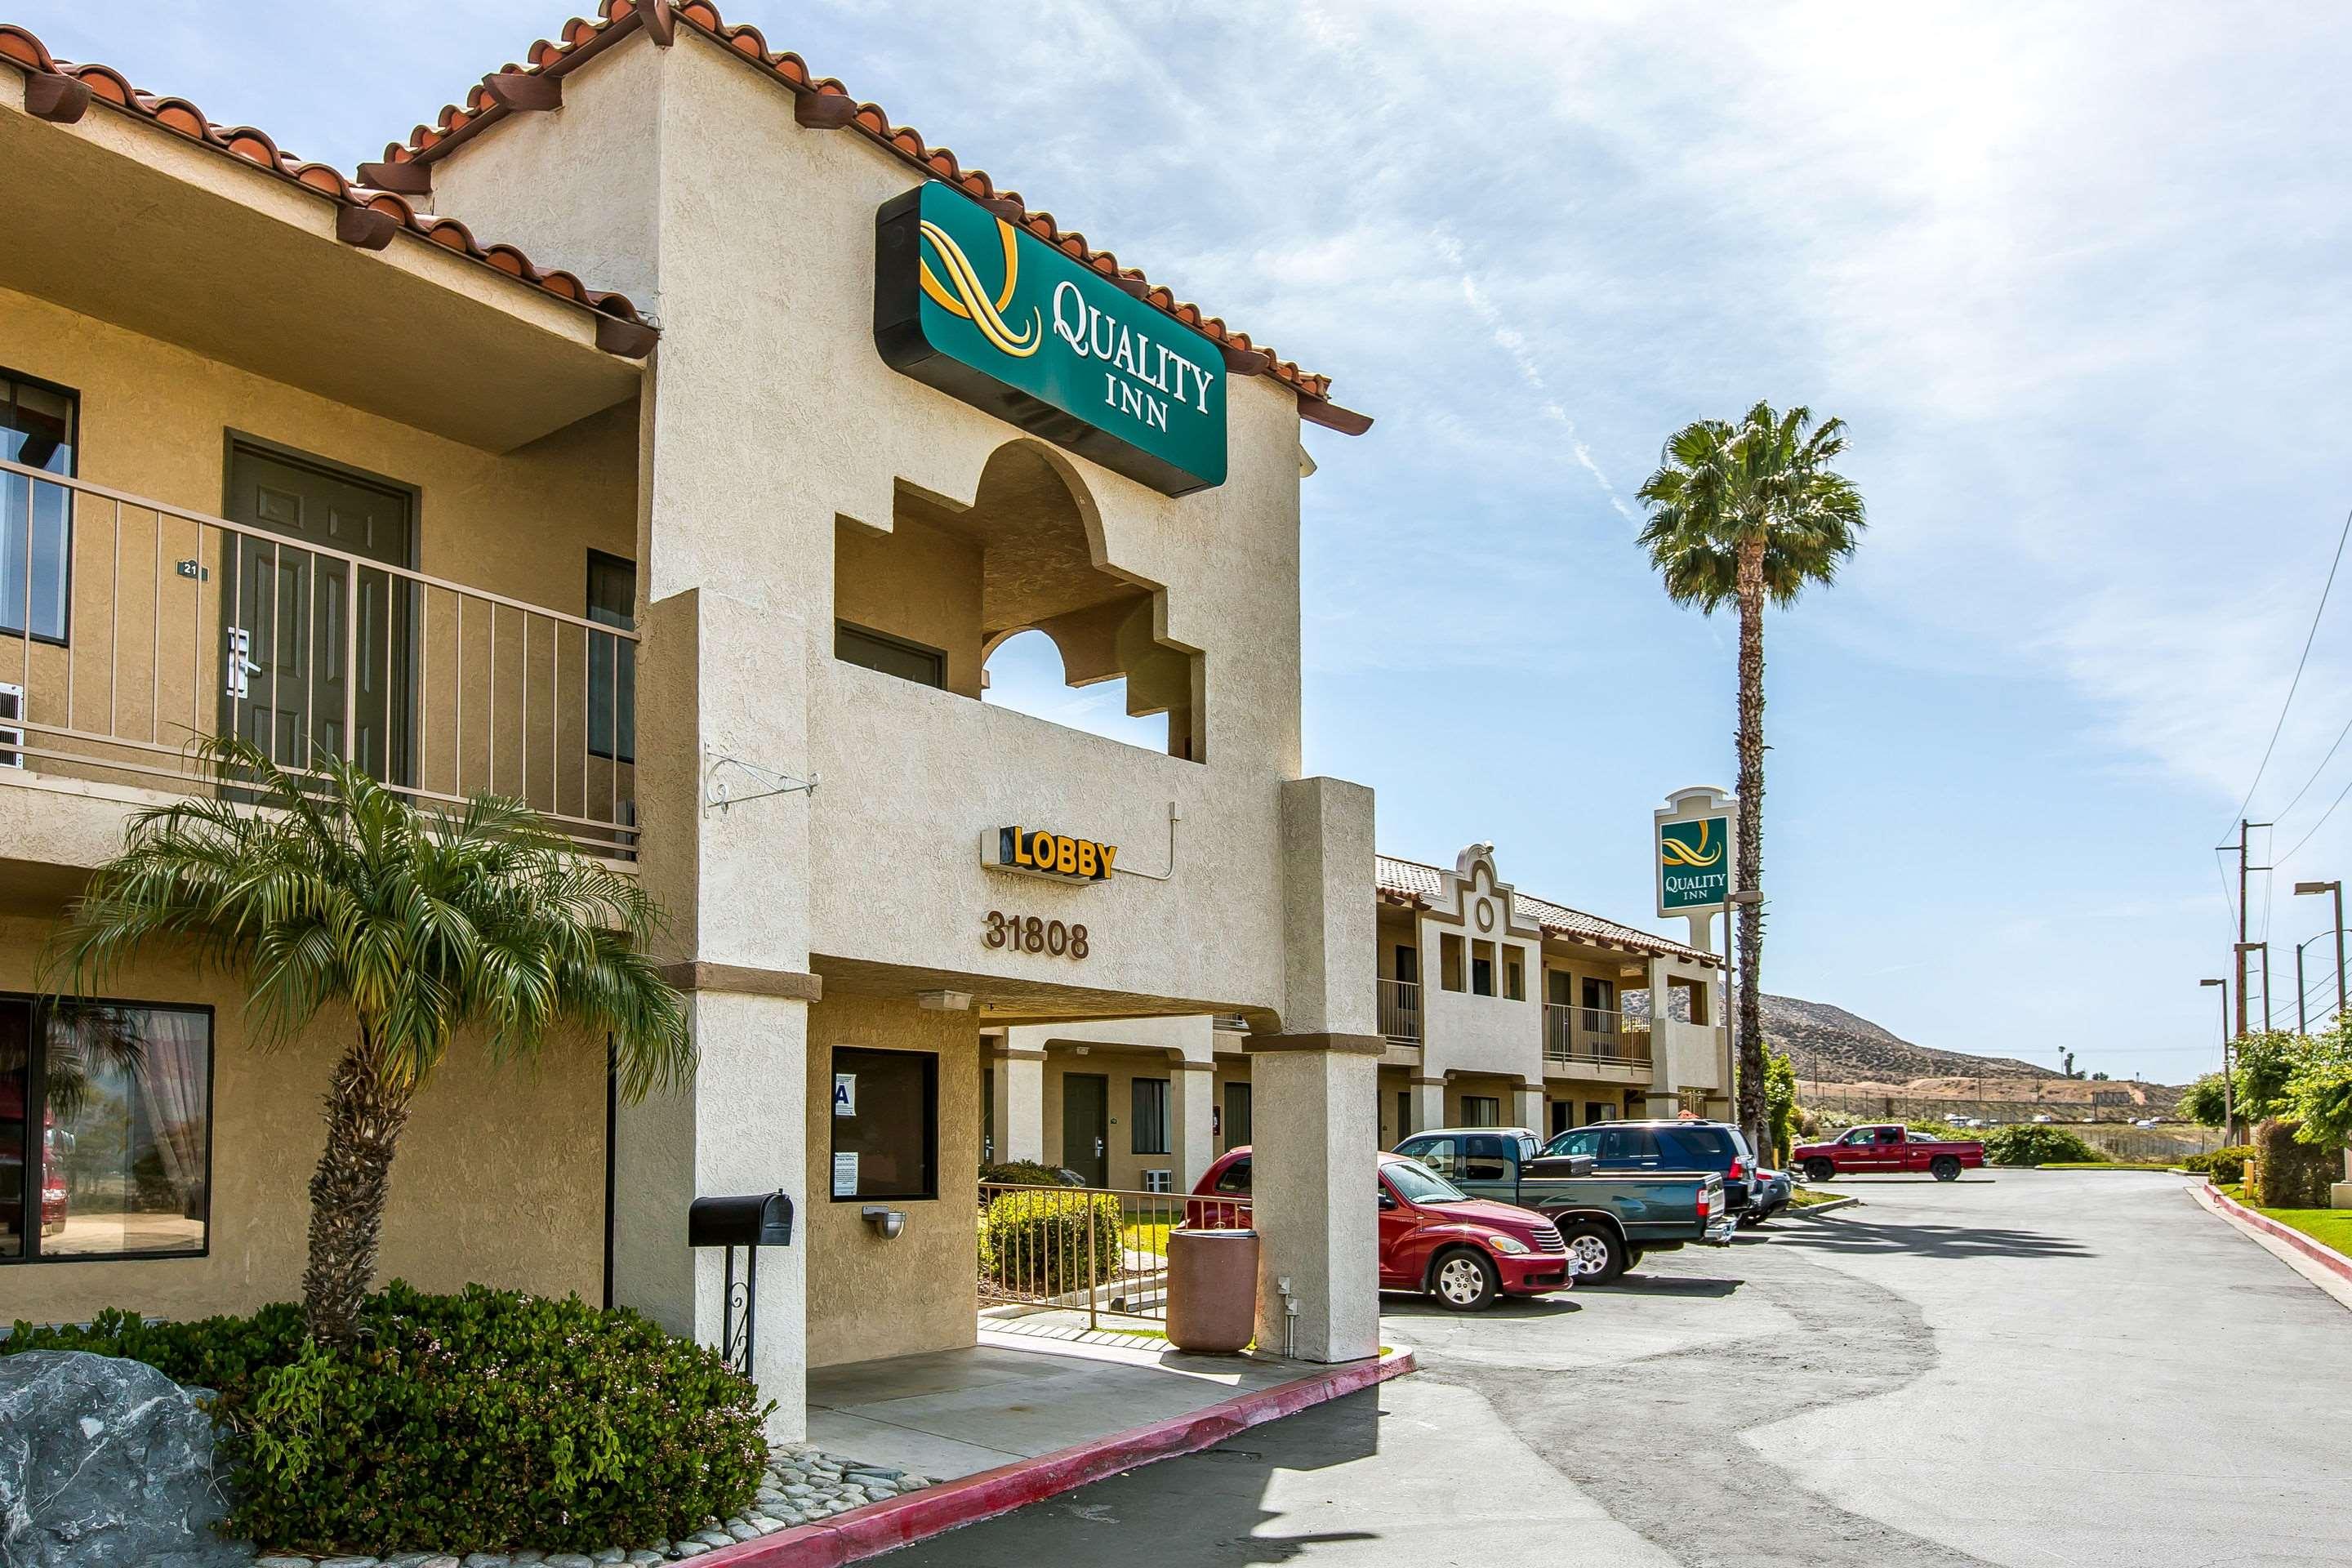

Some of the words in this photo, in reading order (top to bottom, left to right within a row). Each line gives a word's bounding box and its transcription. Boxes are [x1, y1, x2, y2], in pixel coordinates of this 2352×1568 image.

[1053, 281, 1214, 414] QUALITY
[1105, 372, 1169, 433] INN
[184, 564, 201, 576] 21
[1013, 826, 1118, 880] LOBBY
[1665, 873, 1726, 893] QUALITY
[1683, 889, 1708, 900] INN
[986, 911, 1089, 960] 31808
[835, 1085, 849, 1104] A
